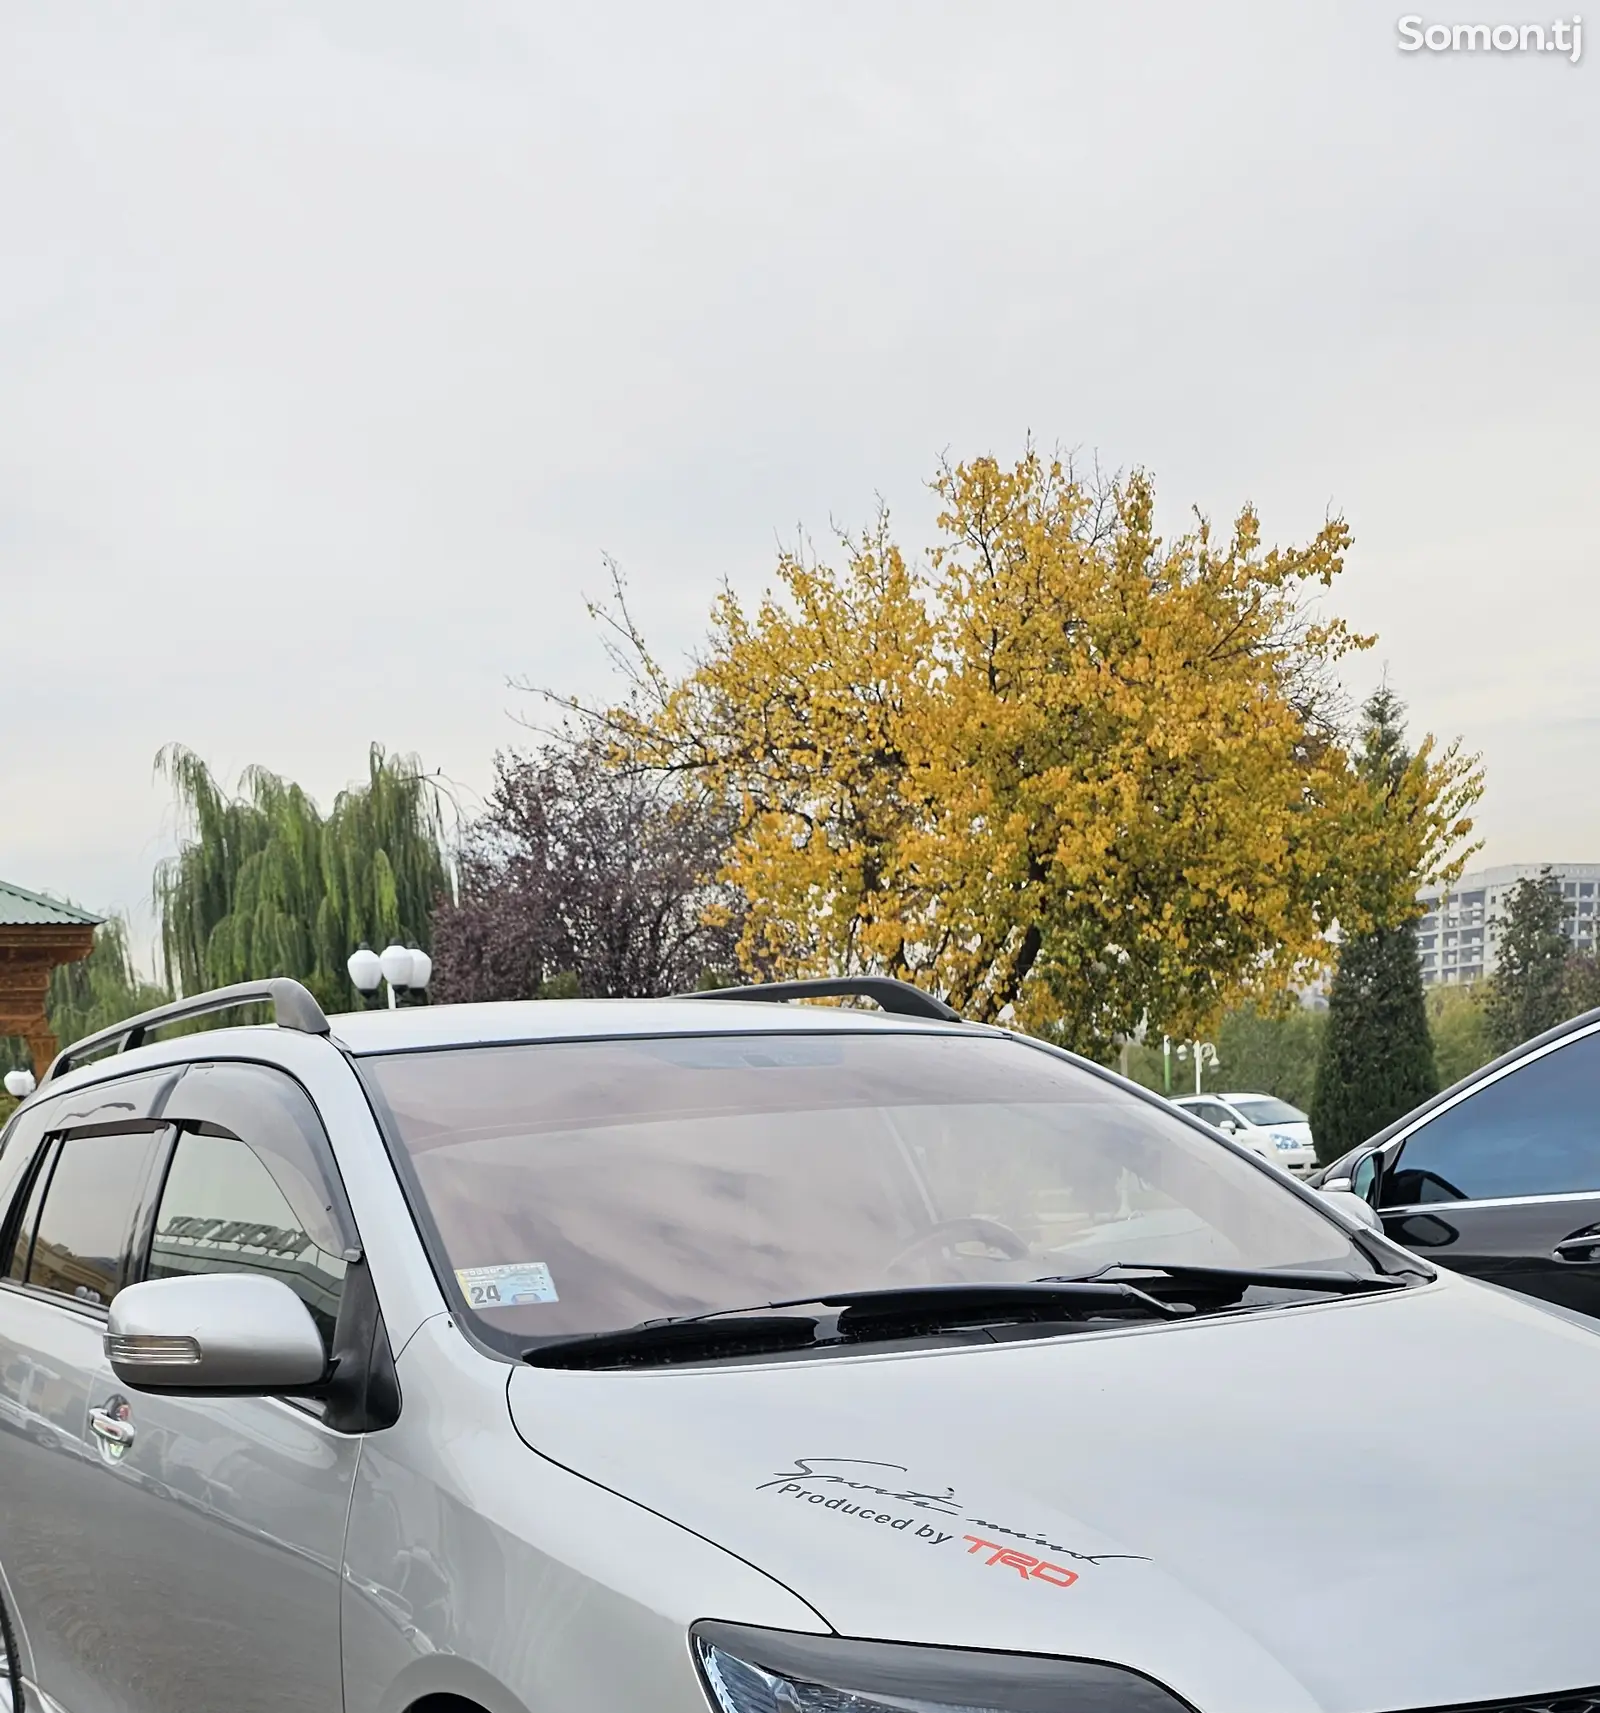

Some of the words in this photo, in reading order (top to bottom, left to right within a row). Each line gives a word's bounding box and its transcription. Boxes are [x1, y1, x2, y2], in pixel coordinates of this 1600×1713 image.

[470, 1284, 501, 1304] 24
[777, 1483, 914, 1531] Produced
[914, 1524, 954, 1545] by
[963, 1535, 1080, 1588] TRD
